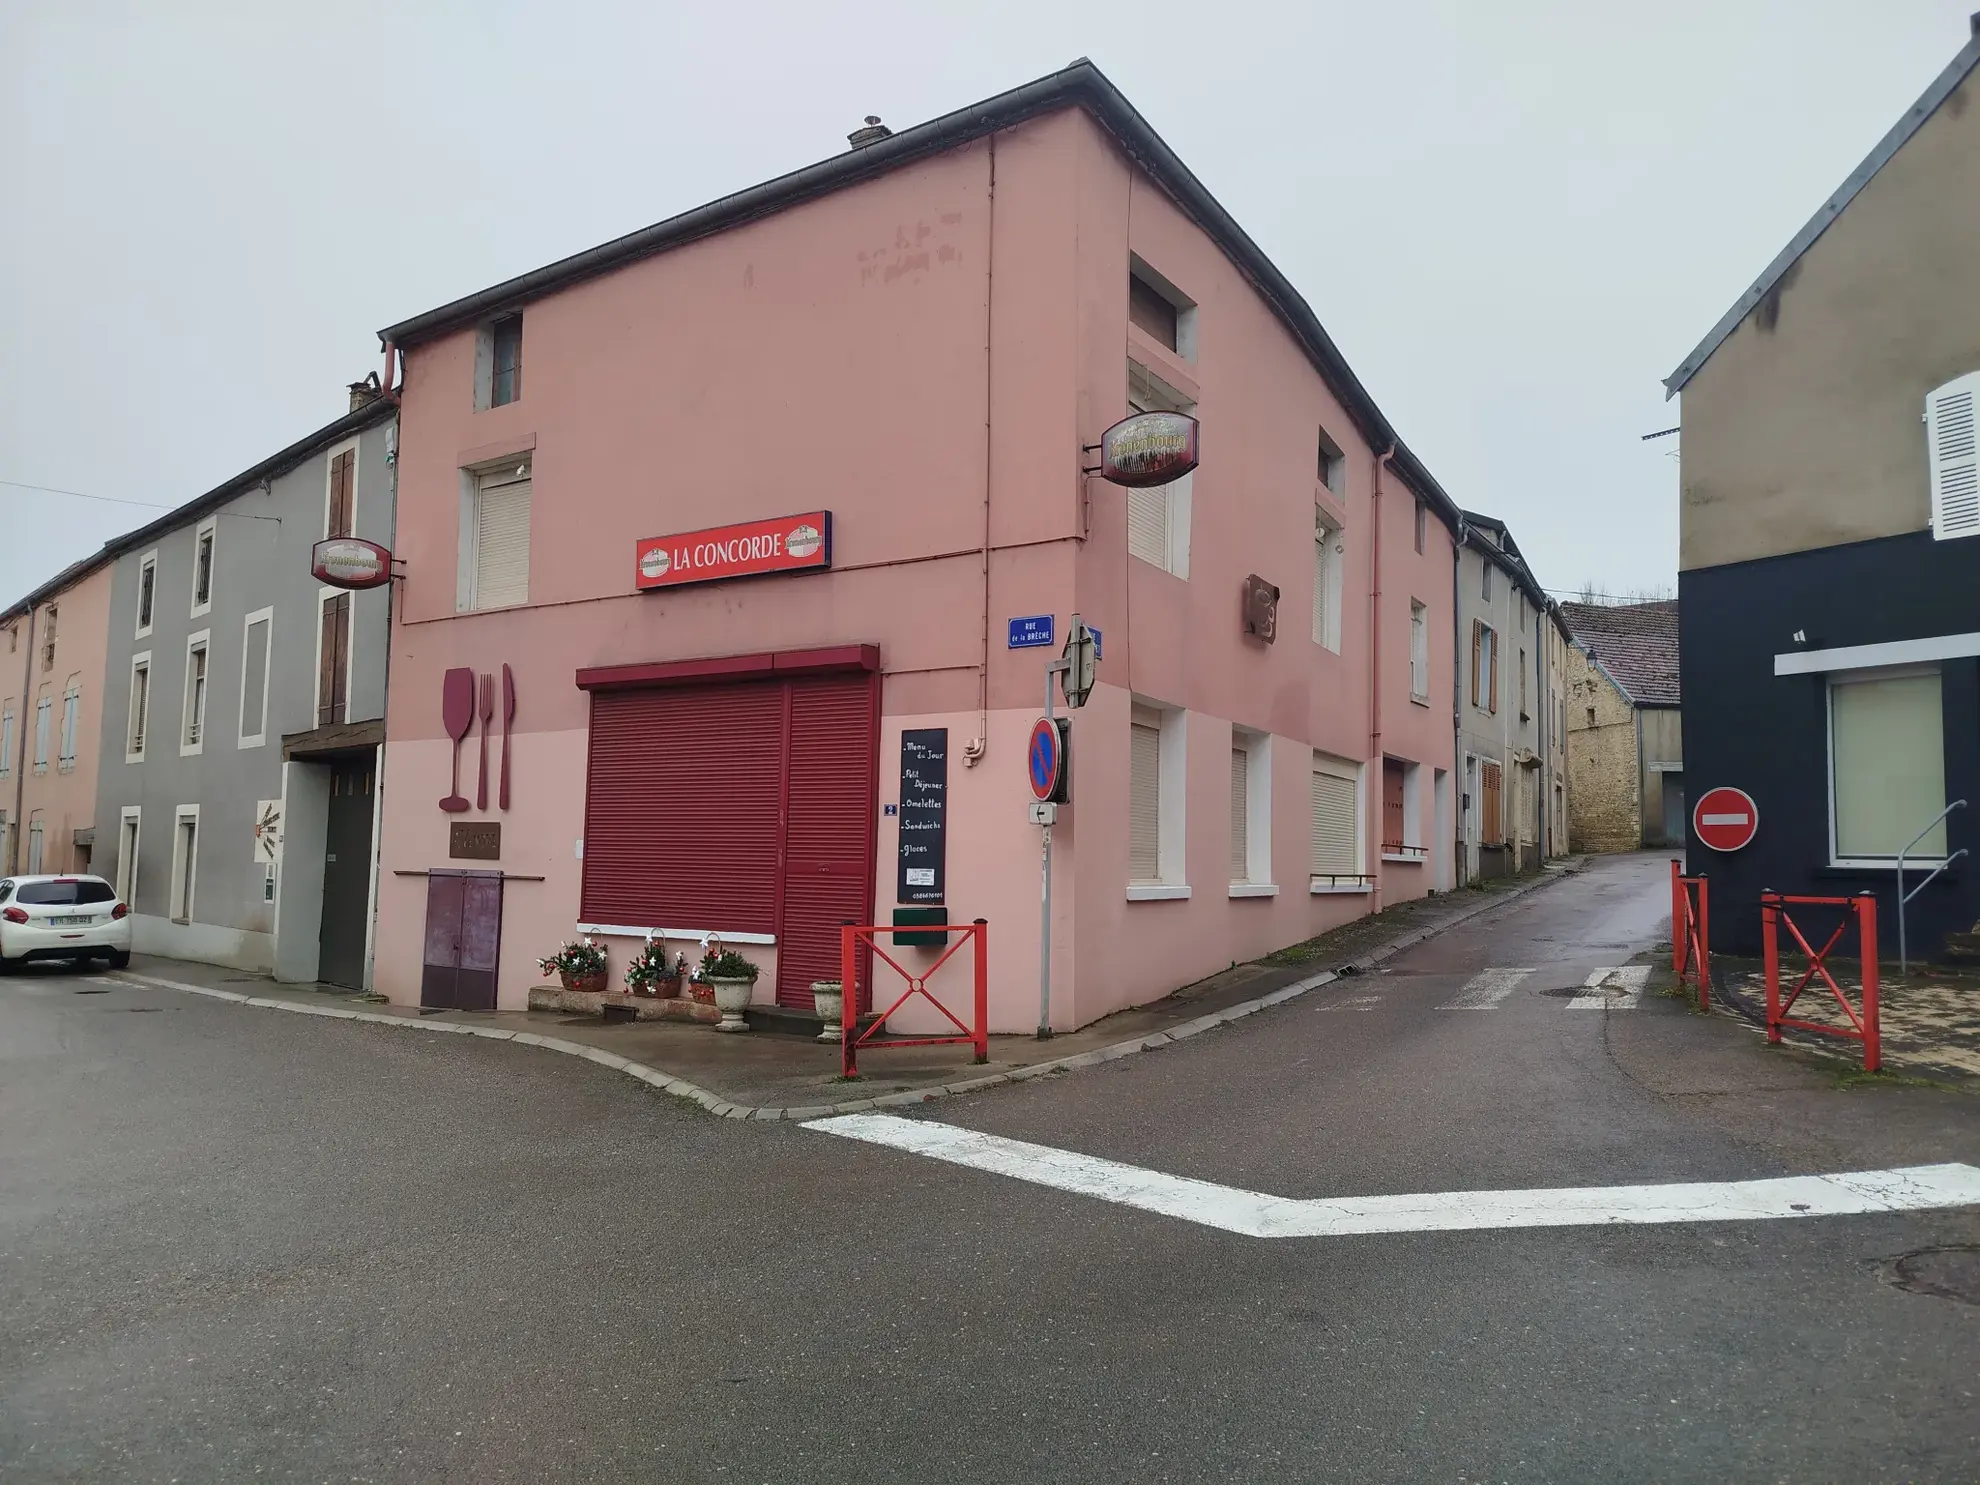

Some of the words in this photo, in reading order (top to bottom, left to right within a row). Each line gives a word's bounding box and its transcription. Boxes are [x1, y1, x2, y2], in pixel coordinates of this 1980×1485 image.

[673, 547, 691, 571] LA
[694, 533, 782, 568] CONCORDE
[1025, 622, 1036, 630] RUE
[1011, 634, 1018, 642] de
[1027, 631, 1050, 641] BRÈCHE
[906, 742, 926, 751] Menu
[926, 750, 944, 760] Jour
[905, 768, 919, 778] Petit
[906, 797, 942, 809] Omelettes
